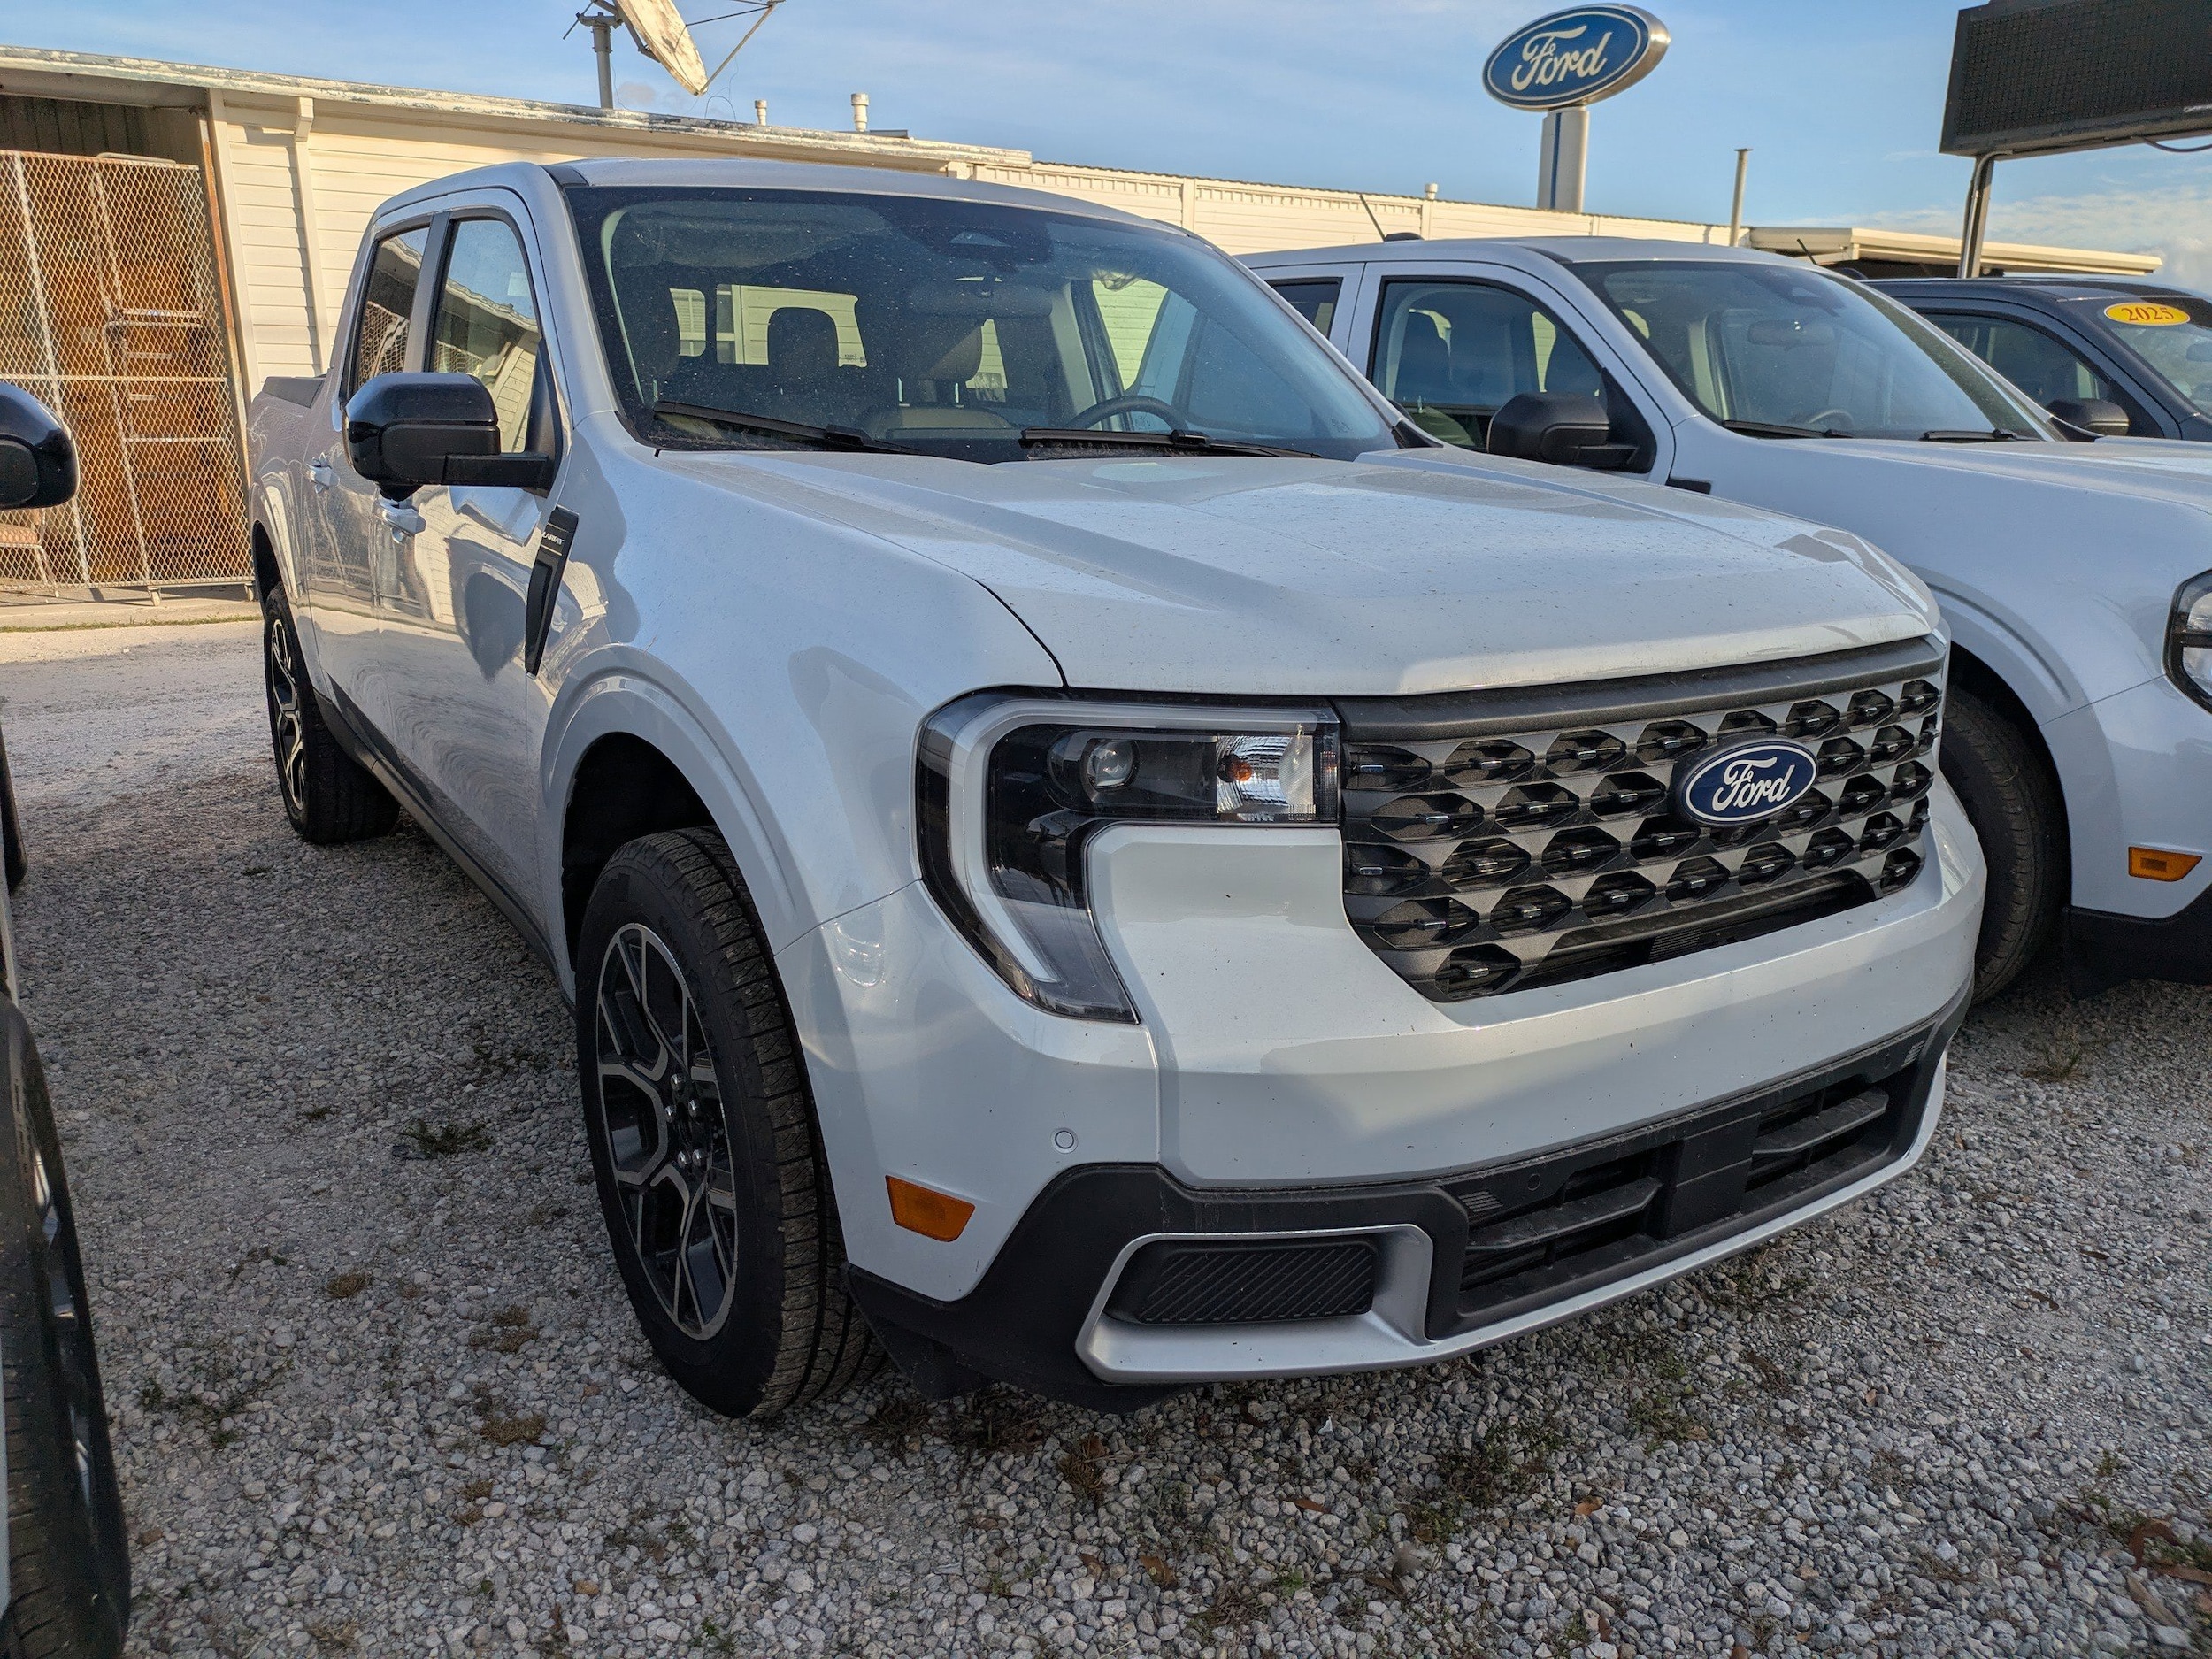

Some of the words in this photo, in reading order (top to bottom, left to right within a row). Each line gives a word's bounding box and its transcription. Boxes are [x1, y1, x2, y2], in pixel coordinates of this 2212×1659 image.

[1511, 25, 1613, 91] Ford
[2121, 306, 2174, 321] 2025
[542, 531, 565, 545] LARIAT
[1712, 756, 1796, 812] Ford
